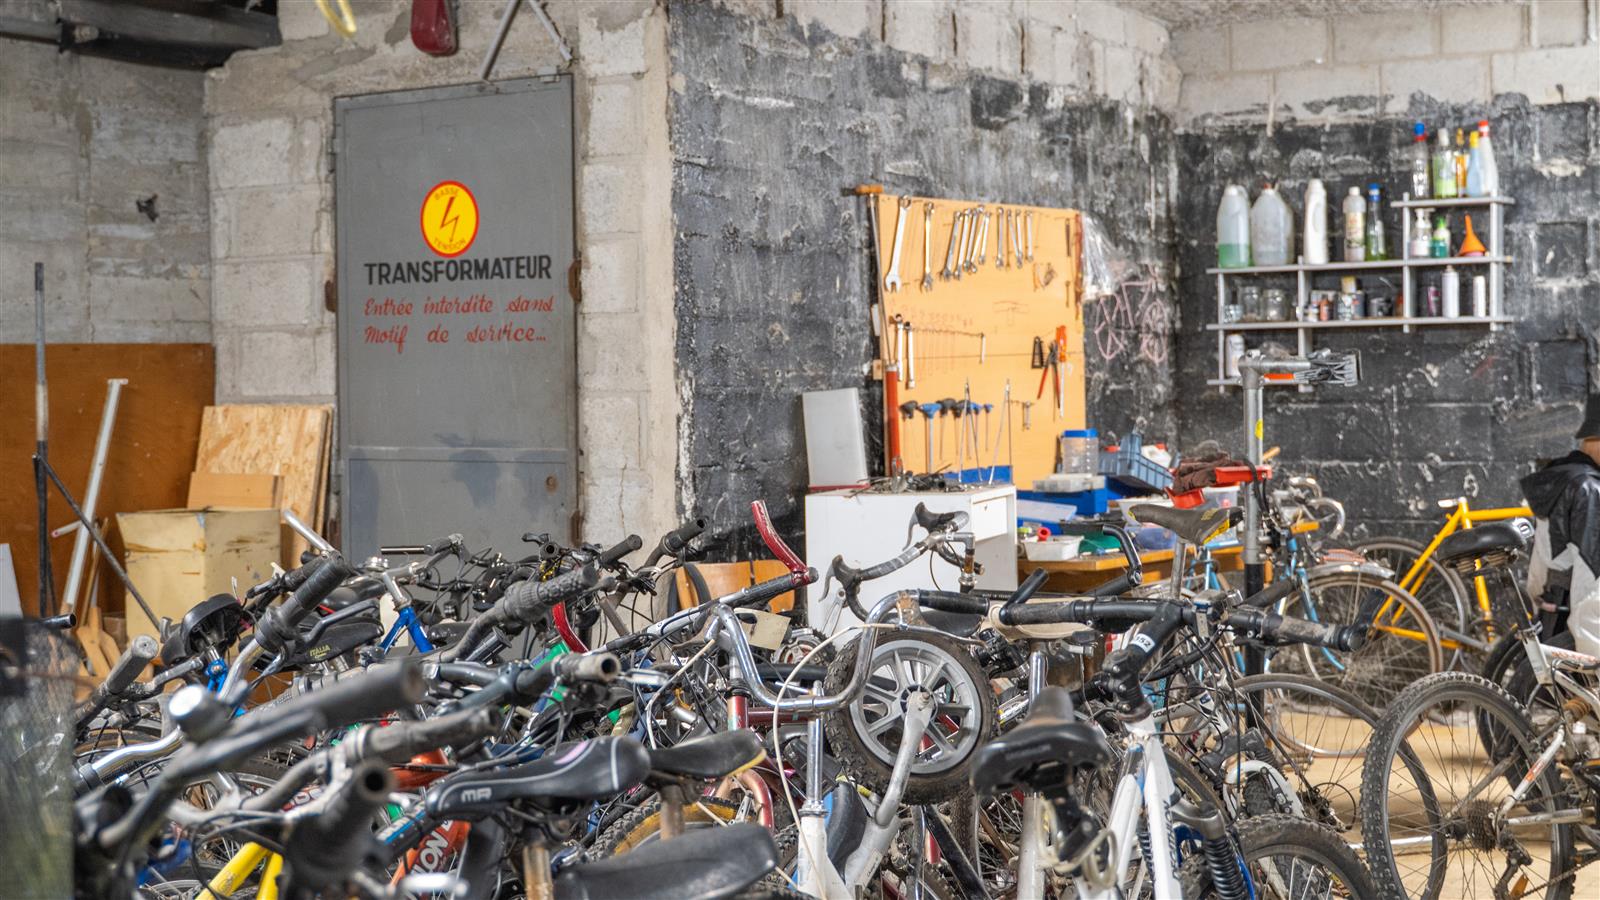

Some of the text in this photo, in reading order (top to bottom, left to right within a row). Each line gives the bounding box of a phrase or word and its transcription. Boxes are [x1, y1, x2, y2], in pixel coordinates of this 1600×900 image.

[434, 187, 459, 200] BASSE
[433, 237, 466, 251] TENSION
[364, 255, 552, 285] TRANSFORMATEUR
[364, 294, 554, 316] Entrée interdite sans
[364, 325, 408, 354] Motif
[427, 324, 449, 343] de
[310, 644, 331, 657] ITALIA
